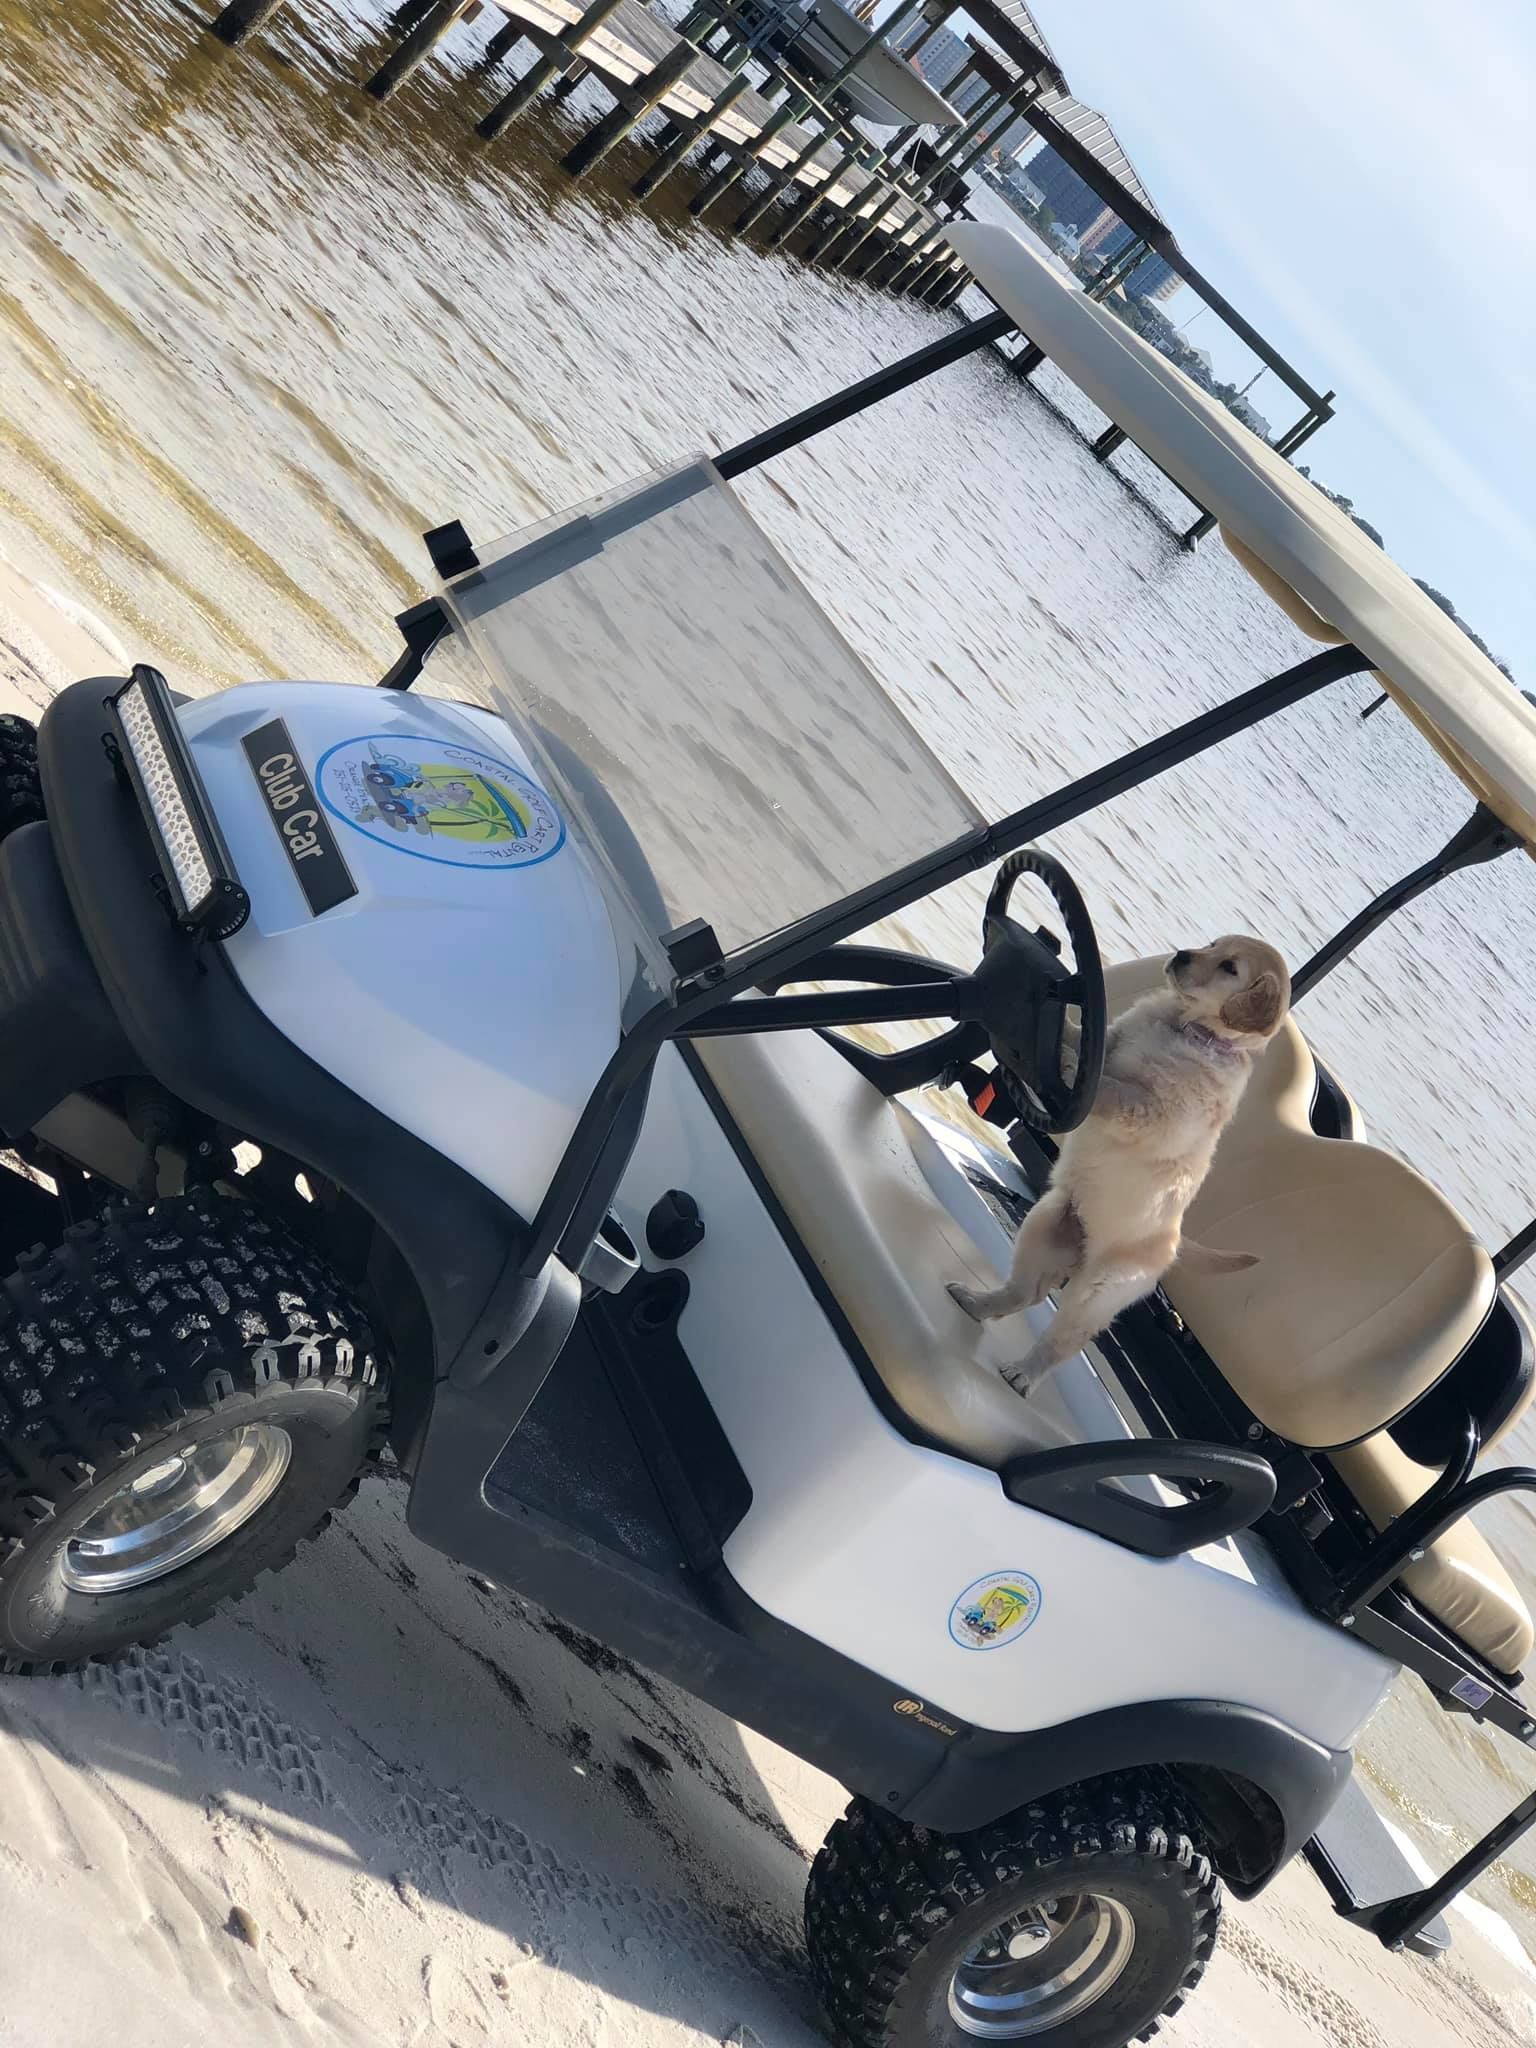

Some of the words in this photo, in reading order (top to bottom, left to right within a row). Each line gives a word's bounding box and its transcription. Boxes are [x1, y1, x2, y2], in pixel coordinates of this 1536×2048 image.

[444, 749, 514, 786] COASTAL
[259, 752, 305, 811] Club
[282, 808, 325, 861] Car
[534, 814, 554, 845] CART
[470, 841, 539, 859] RENTAL
